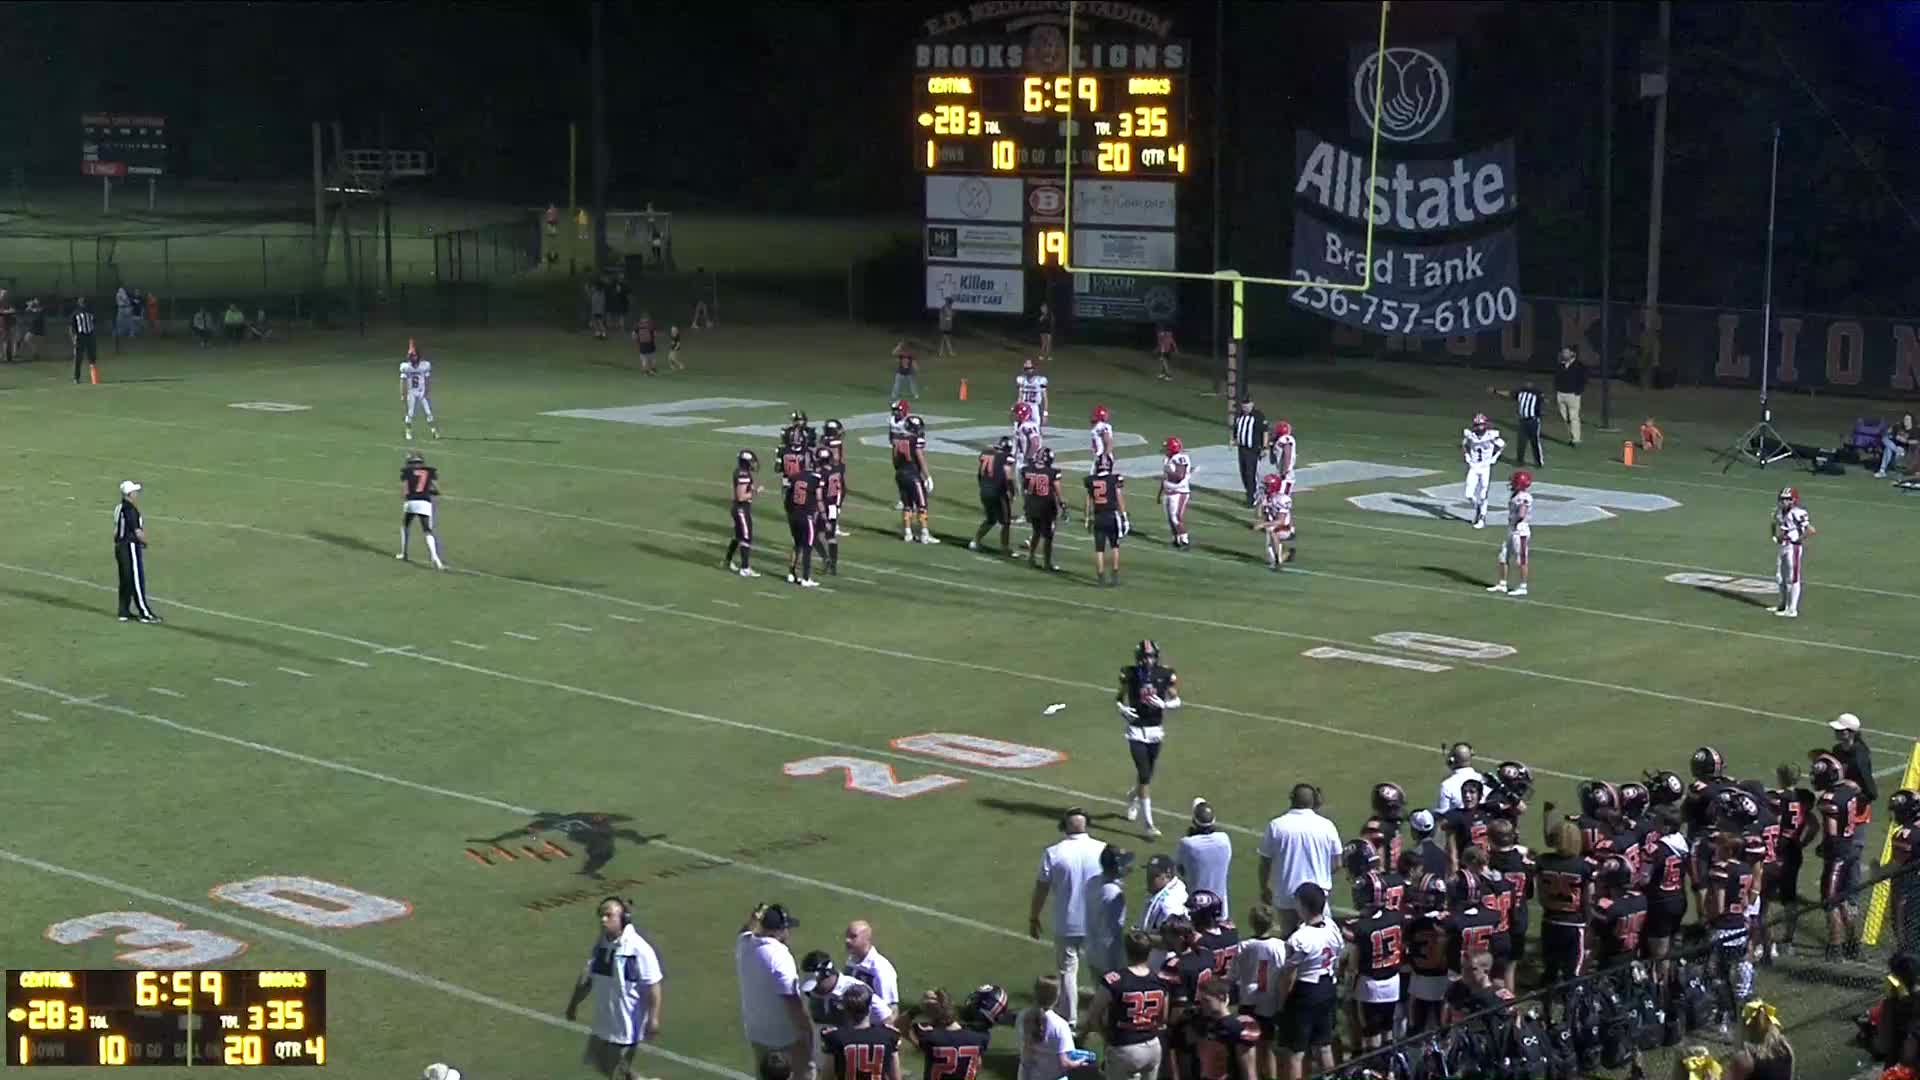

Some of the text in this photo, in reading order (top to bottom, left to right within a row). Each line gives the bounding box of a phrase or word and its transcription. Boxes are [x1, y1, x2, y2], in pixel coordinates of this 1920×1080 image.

[916, 44, 1184, 68] BROOKS LIONS
[1023, 77, 1097, 112] 6:59
[934, 105, 965, 134] 28
[967, 111, 981, 136] 3
[1118, 112, 1132, 137] 3
[1134, 107, 1168, 137] 35
[927, 139, 935, 168] 1
[992, 140, 1015, 170] 10
[1097, 142, 1131, 172] 20
[1141, 144, 1185, 173] QTR 4
[1295, 141, 1505, 230] Allstate
[1038, 231, 1064, 265] 19
[1325, 233, 1484, 287] Brad Tank
[1291, 269, 1517, 333] 256-757-6100
[414, 469, 429, 492] 7
[1093, 480, 1107, 504] 2
[1300, 631, 1518, 673] 10
[784, 731, 1067, 799] 20
[45, 874, 413, 968] 30
[1371, 925, 1401, 969] 13
[844, 1044, 885, 1080] 14
[931, 1045, 981, 1080] 27
